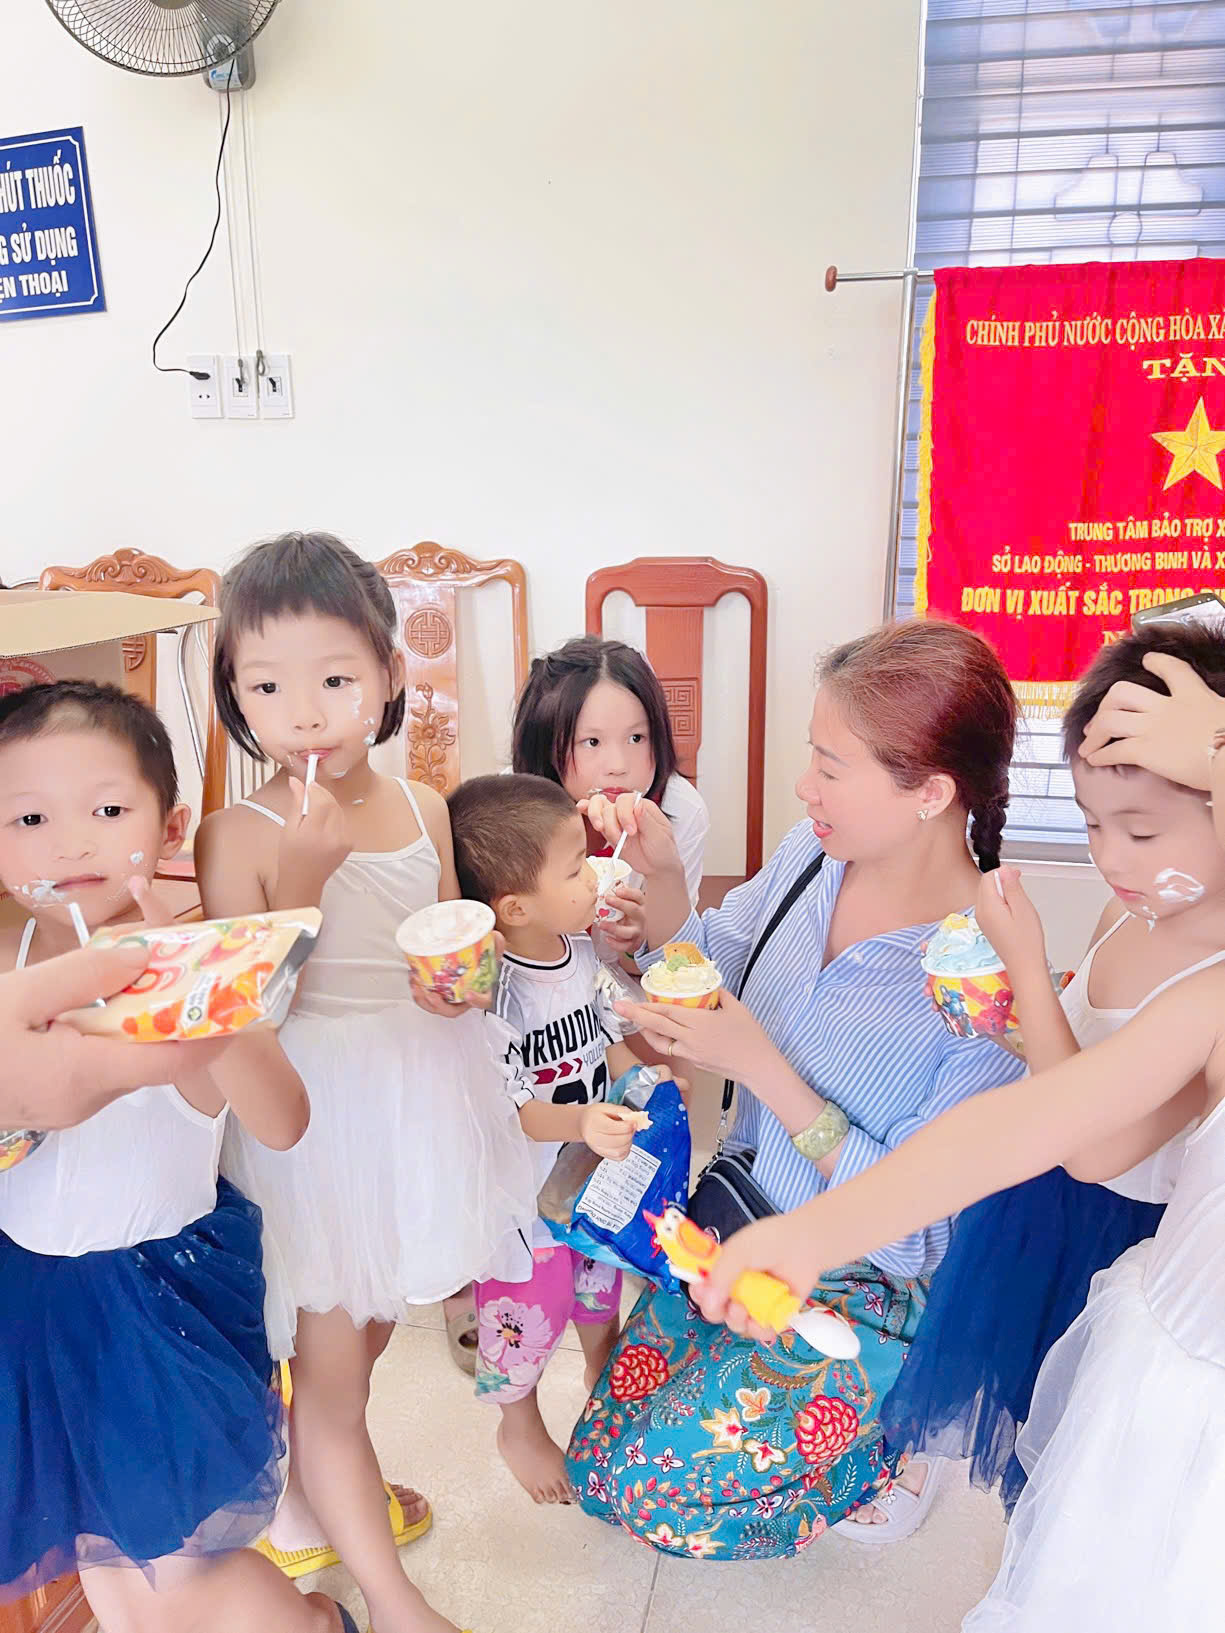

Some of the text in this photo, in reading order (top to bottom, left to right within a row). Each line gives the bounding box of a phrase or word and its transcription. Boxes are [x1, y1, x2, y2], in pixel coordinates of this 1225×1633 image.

[25, 149, 75, 208] THUỐC
[10, 222, 32, 264] SỬ
[34, 225, 78, 265] DỤNG
[19, 270, 69, 297] THOẠI
[966, 315, 1020, 346] CHÍNH
[1023, 310, 1059, 346] PHỦ
[1063, 312, 1112, 345] NƯỚC
[1115, 312, 1165, 351] CỘNG
[1168, 307, 1206, 341] HÒA
[1069, 522, 1113, 541] TRUNG
[1117, 516, 1148, 540] TÂM
[1151, 512, 1181, 538] BẢO
[1184, 517, 1213, 542] TRỢ
[992, 546, 1011, 573] SỞ
[1014, 555, 1041, 573] LAO
[1044, 550, 1083, 578] ĐỘNG
[1094, 553, 1151, 573] THƯƠNG
[1155, 551, 1188, 570] BINH
[1191, 545, 1212, 569] VÀ
[961, 586, 1001, 613] ĐƠN
[1005, 589, 1024, 620] VỊ
[1028, 582, 1079, 616] XUẤT
[1083, 583, 1123, 616] SẮC
